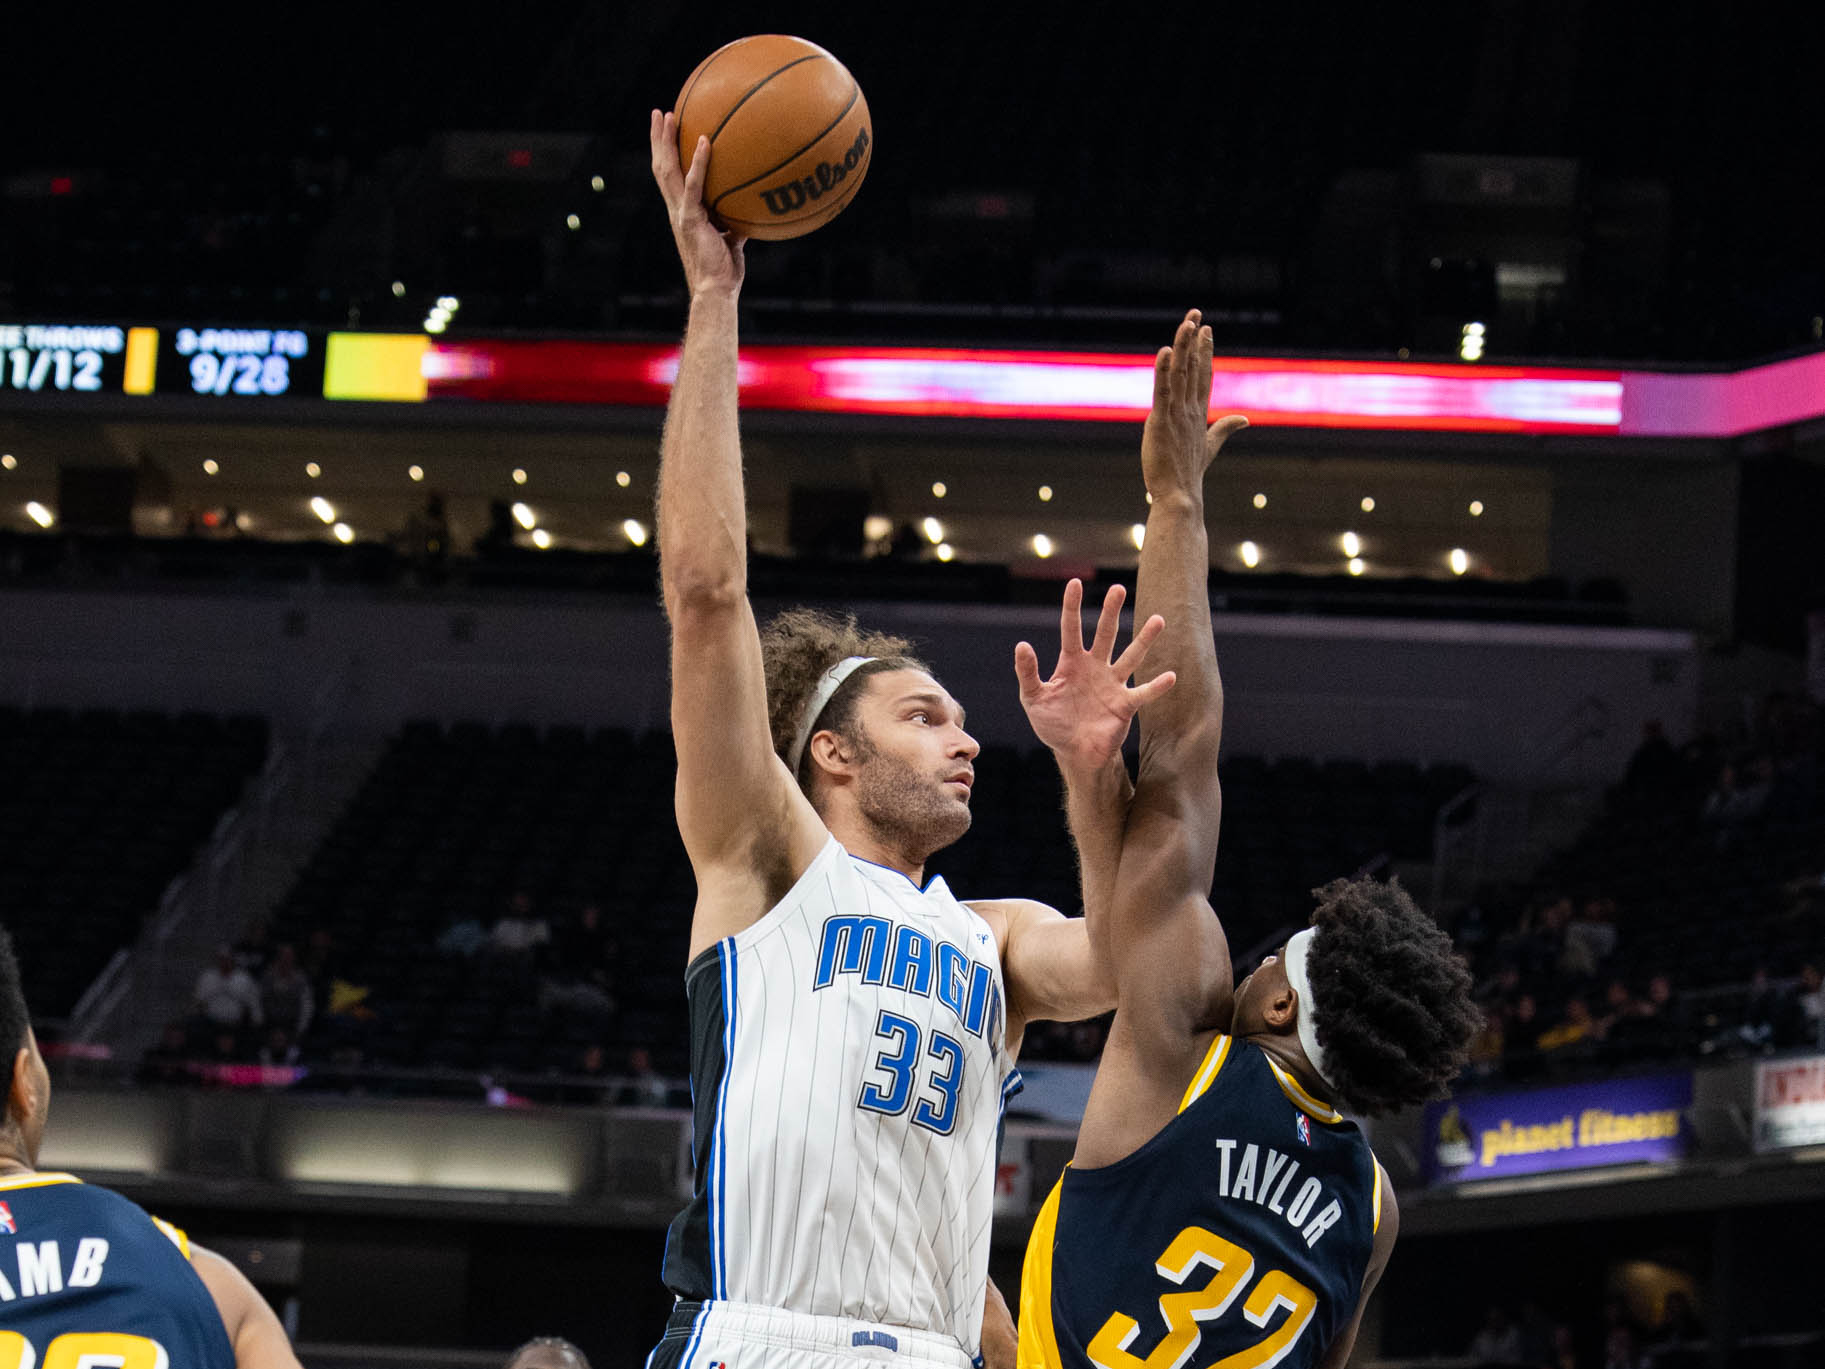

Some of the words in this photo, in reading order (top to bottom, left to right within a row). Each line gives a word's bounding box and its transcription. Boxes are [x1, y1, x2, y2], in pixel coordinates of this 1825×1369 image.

[760, 127, 870, 216] Wilson
[0, 348, 103, 391] 1/12
[190, 353, 289, 395] 9/28
[857, 1009, 965, 1136] 33
[1480, 1114, 1575, 1167] planet
[1577, 1109, 1680, 1147] fitness
[1216, 1139, 1342, 1248] TAYLOR
